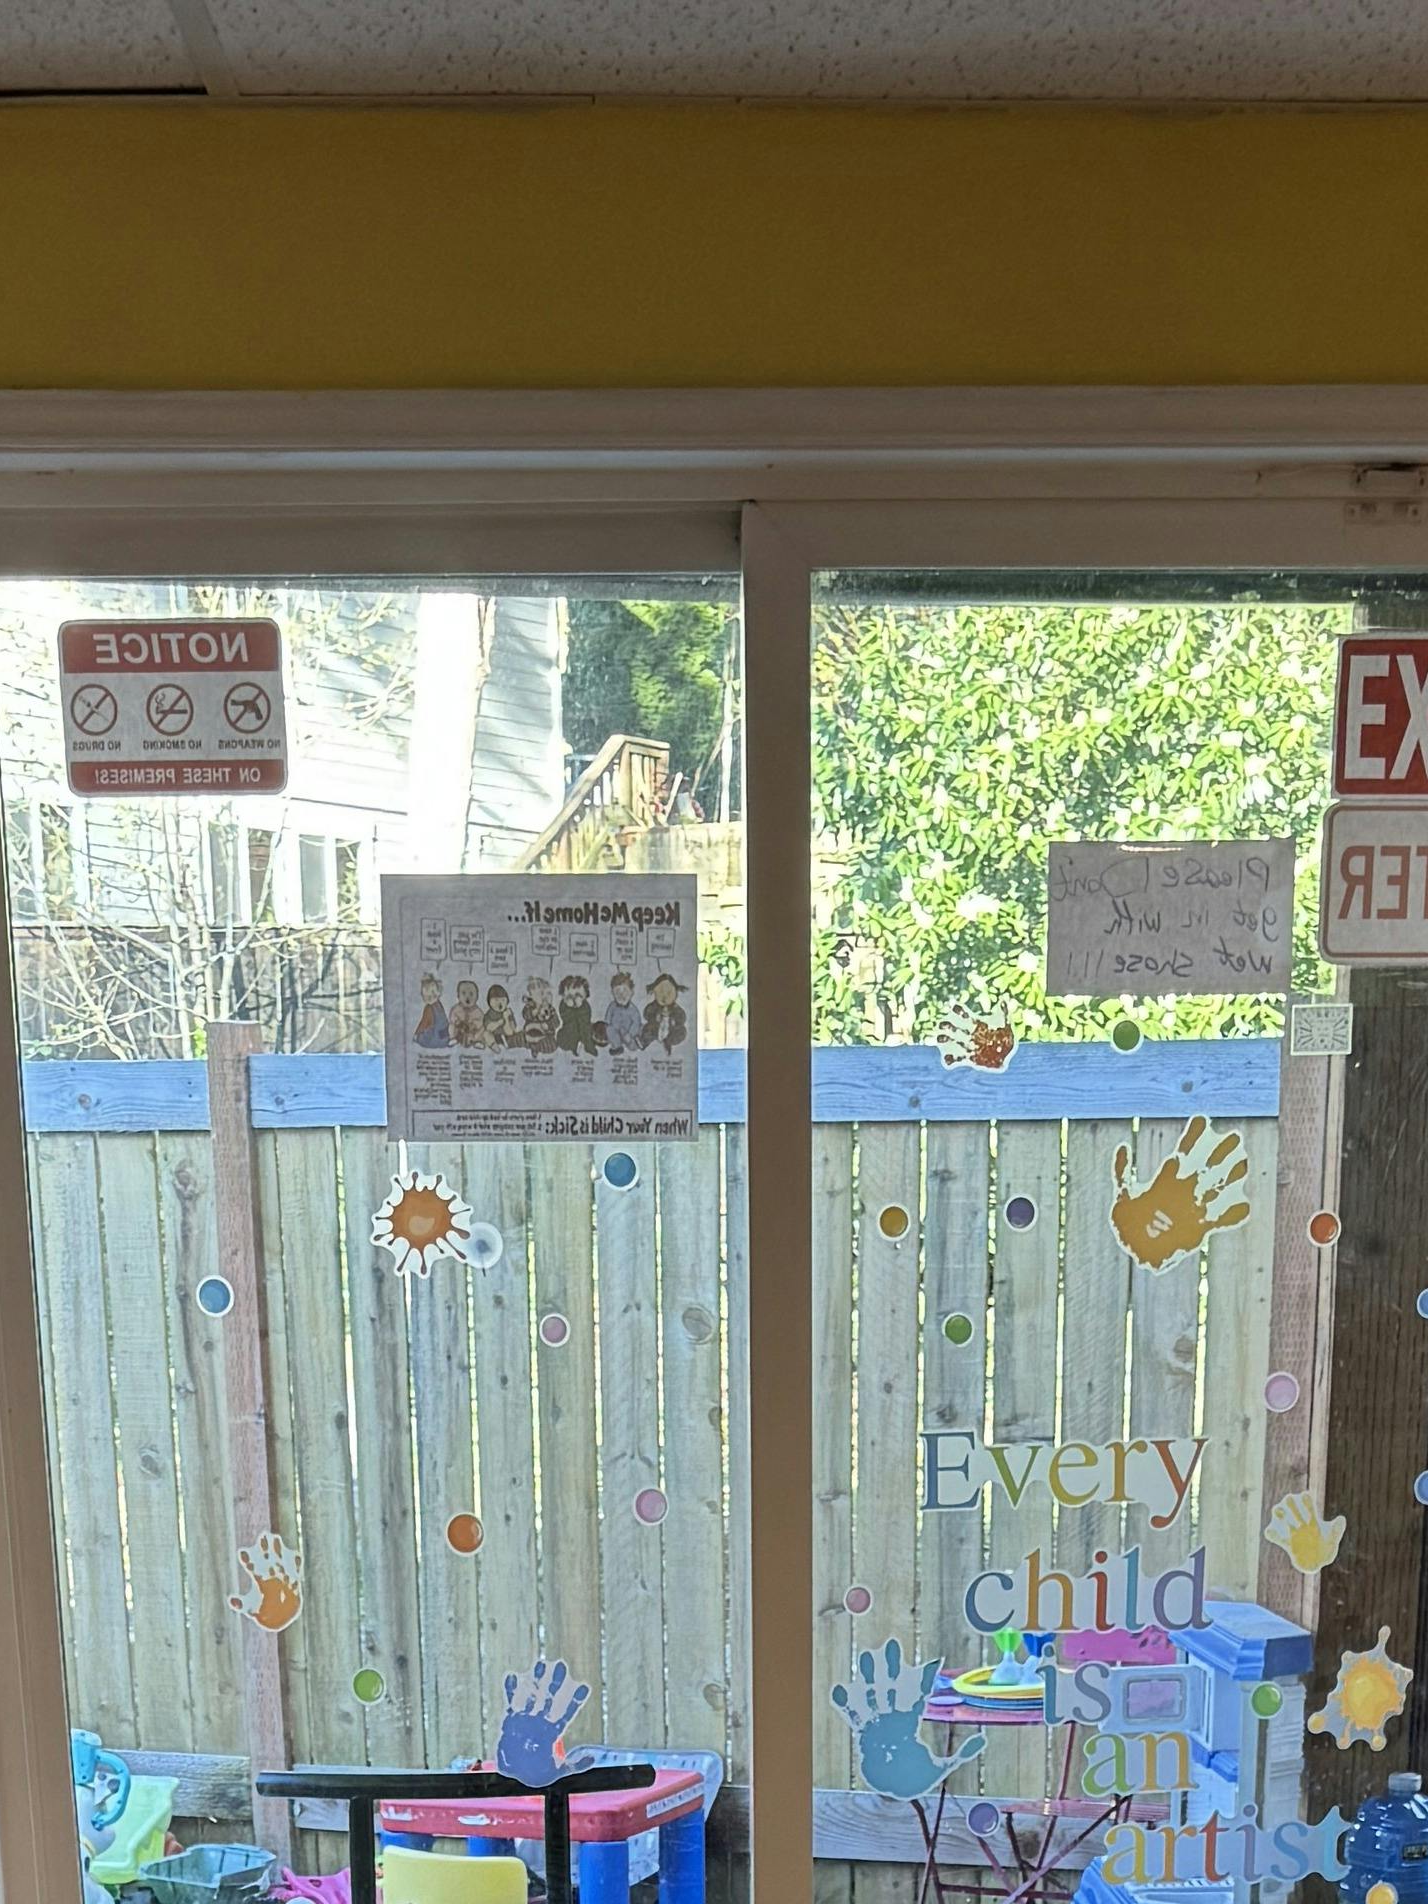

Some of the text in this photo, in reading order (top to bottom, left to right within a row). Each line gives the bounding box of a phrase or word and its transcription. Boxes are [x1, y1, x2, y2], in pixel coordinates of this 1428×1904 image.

[920, 1430, 1209, 1529] Every
[965, 1545, 1213, 1633] child
[1038, 1643, 1113, 1726] is
[1082, 1731, 1197, 1795] an
[1100, 1804, 1352, 1886] artist
